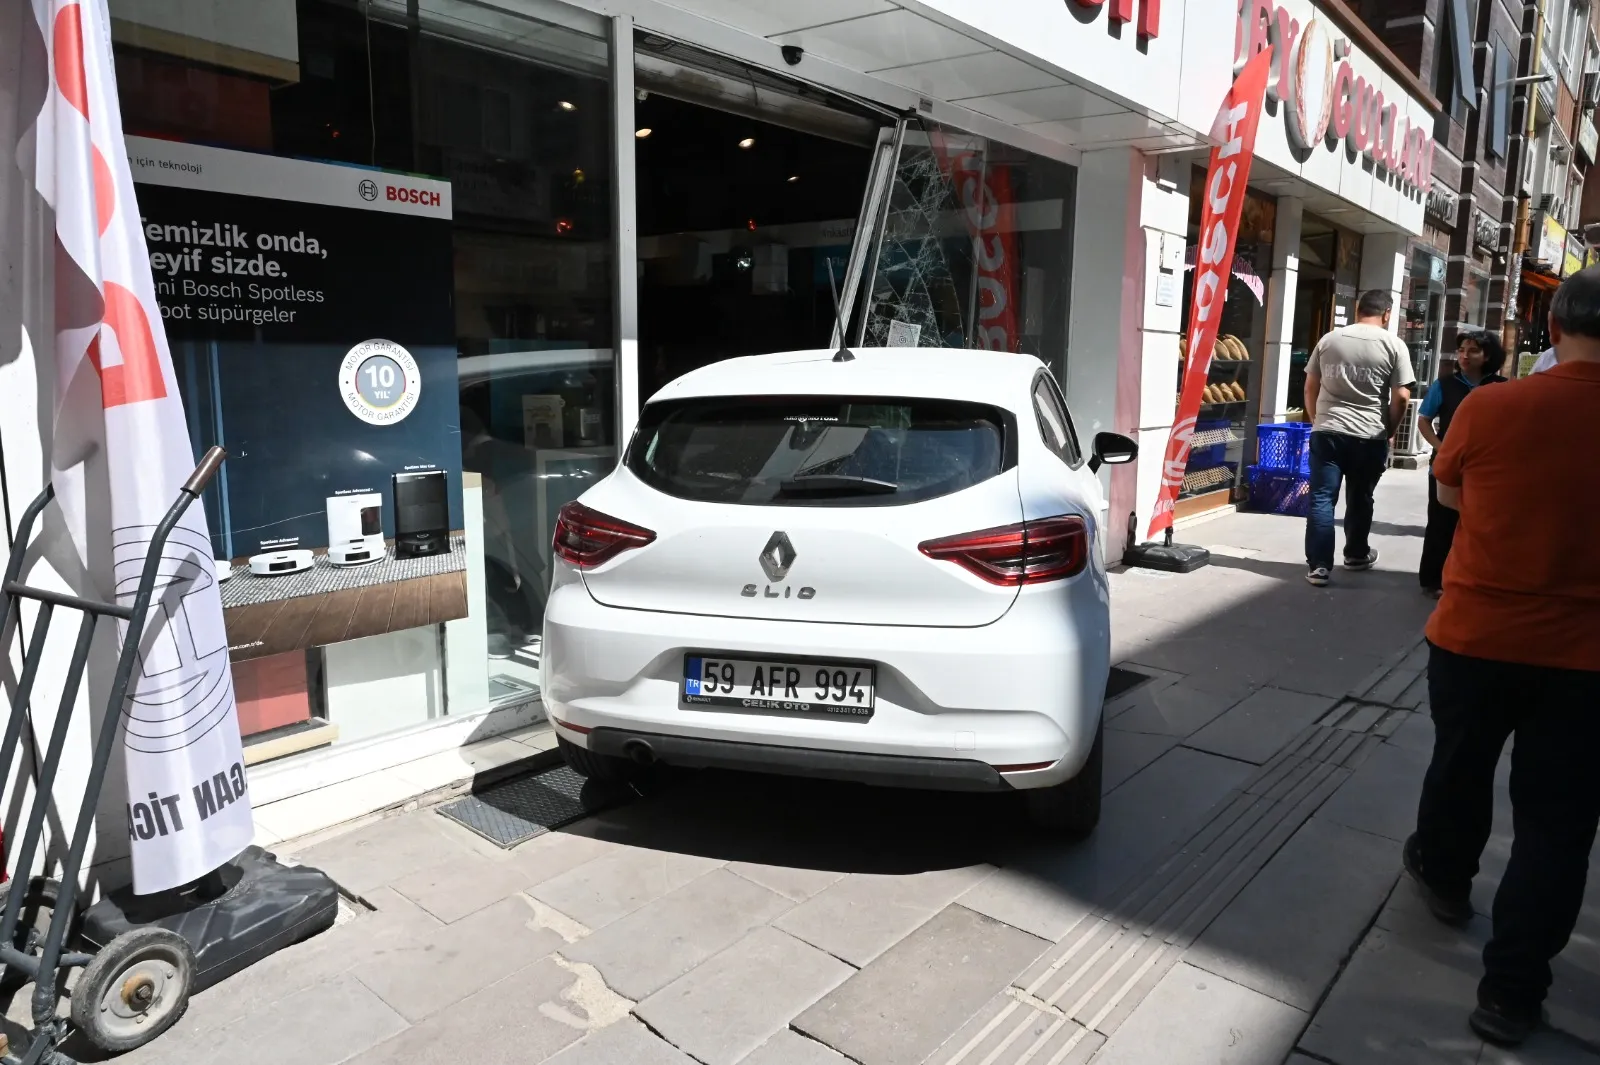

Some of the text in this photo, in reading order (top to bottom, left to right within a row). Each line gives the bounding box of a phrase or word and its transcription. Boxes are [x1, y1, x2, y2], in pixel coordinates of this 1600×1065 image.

[136, 157, 155, 167] için
[158, 160, 203, 175] teknoloji
[386, 185, 440, 206] BOSCH
[256, 231, 328, 259] onda,
[211, 251, 288, 278] sizde.
[154, 278, 325, 303] ni Bosch Spotless
[198, 303, 296, 325] süpürgeler
[345, 344, 371, 371] MOTOR
[365, 365, 395, 388] 10
[348, 392, 375, 419] MOTOR
[740, 583, 817, 600] CLIO
[688, 679, 700, 688] TR
[703, 662, 865, 703] 59 AFR 994
[783, 701, 810, 711] OTO
